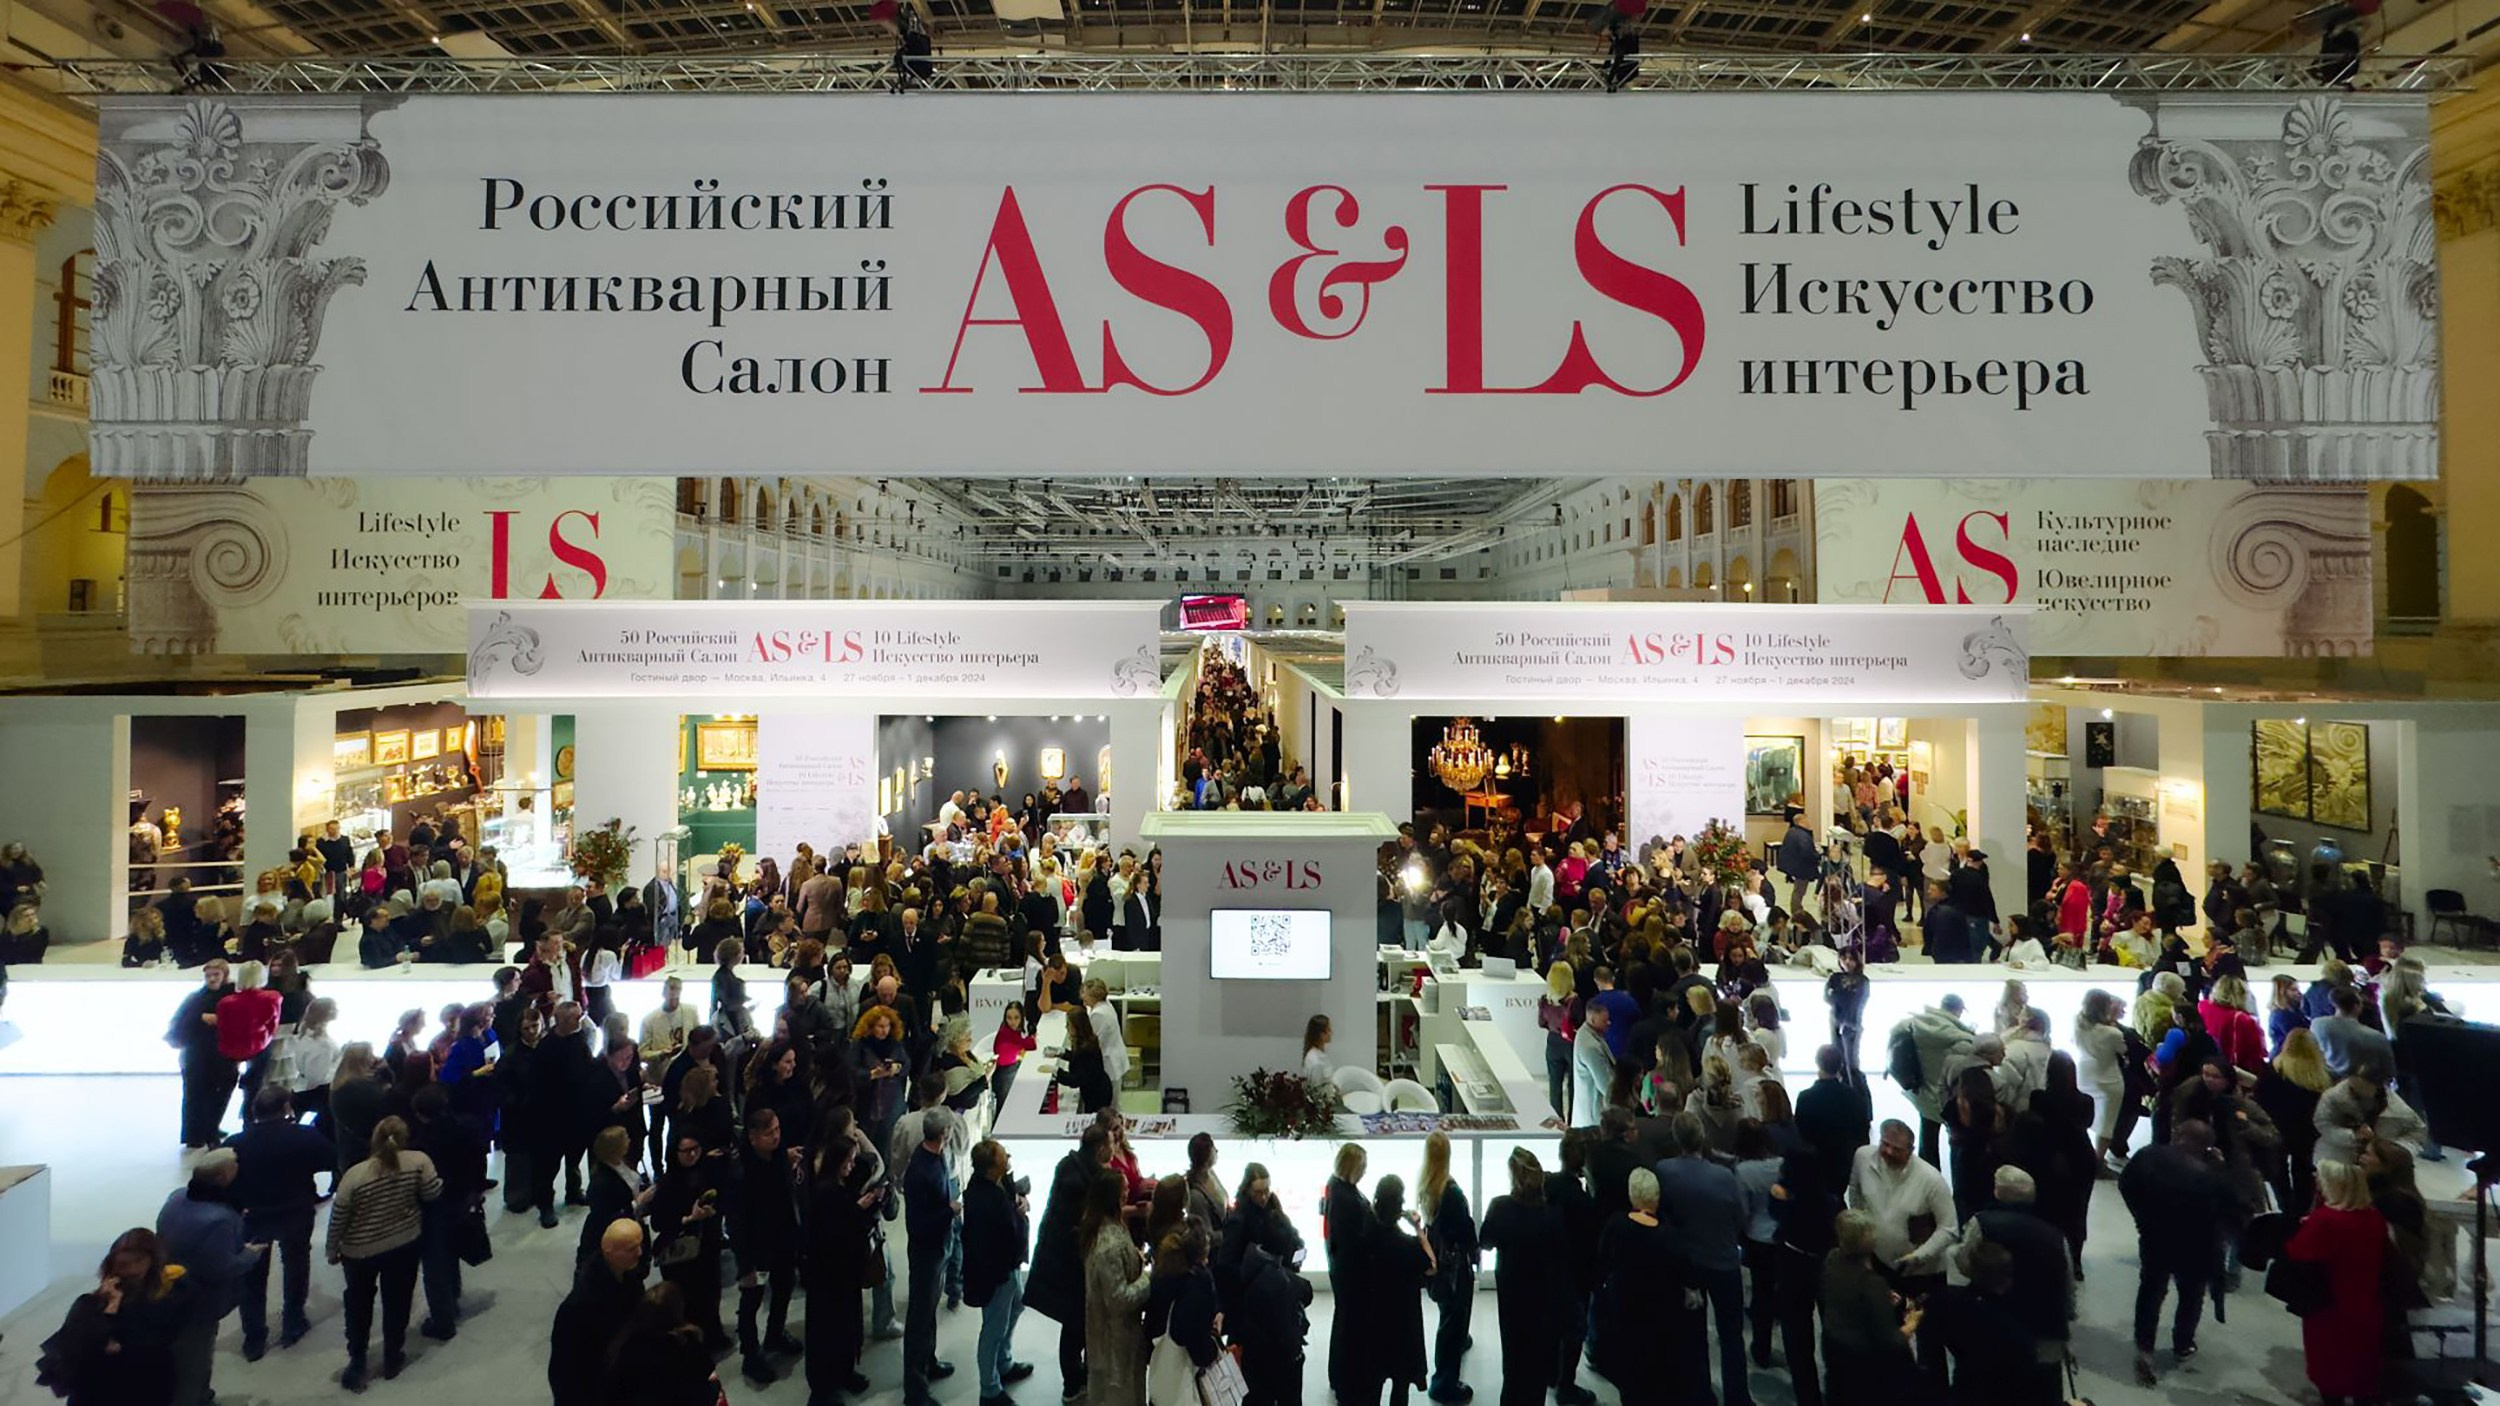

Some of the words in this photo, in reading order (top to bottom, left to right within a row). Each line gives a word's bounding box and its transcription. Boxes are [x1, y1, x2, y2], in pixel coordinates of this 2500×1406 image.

[478, 177, 894, 231] Российский
[1738, 183, 2020, 251] Lifestyle
[404, 259, 894, 328] Антикварный
[1738, 262, 2094, 331] Искусство
[680, 339, 892, 395] Салон
[1738, 359, 2091, 411] интерьера
[358, 511, 460, 539] Lifestyle
[2037, 510, 2172, 535] Культурное
[1883, 510, 2019, 604] AS
[2037, 537, 2140, 555] наследие
[330, 548, 460, 576] Искусство
[2037, 569, 2172, 593] Ювелирное
[620, 631, 639, 644] 50
[646, 630, 738, 645] Российский
[748, 630, 864, 663] AS&LS
[874, 631, 891, 645] 10
[897, 630, 961, 649] Lifestyle
[1495, 632, 1514, 647] 50
[1520, 632, 1611, 647] Российский
[1622, 633, 1735, 666] AS&LS
[1744, 633, 1762, 648] 10
[1768, 633, 1831, 651] Lifestyle
[576, 649, 684, 666] Антикварный
[690, 649, 738, 663] Салон
[872, 649, 954, 667] Искусство
[960, 651, 1040, 666] интерьера
[1452, 651, 1560, 668] Антикварный
[1564, 651, 1611, 665] Салон
[1743, 652, 1824, 669] Искусство
[1829, 654, 1908, 669] интерьера
[961, 673, 986, 682] 2024
[1831, 676, 1855, 685] 2024
[1218, 860, 1322, 889] AS&LS
